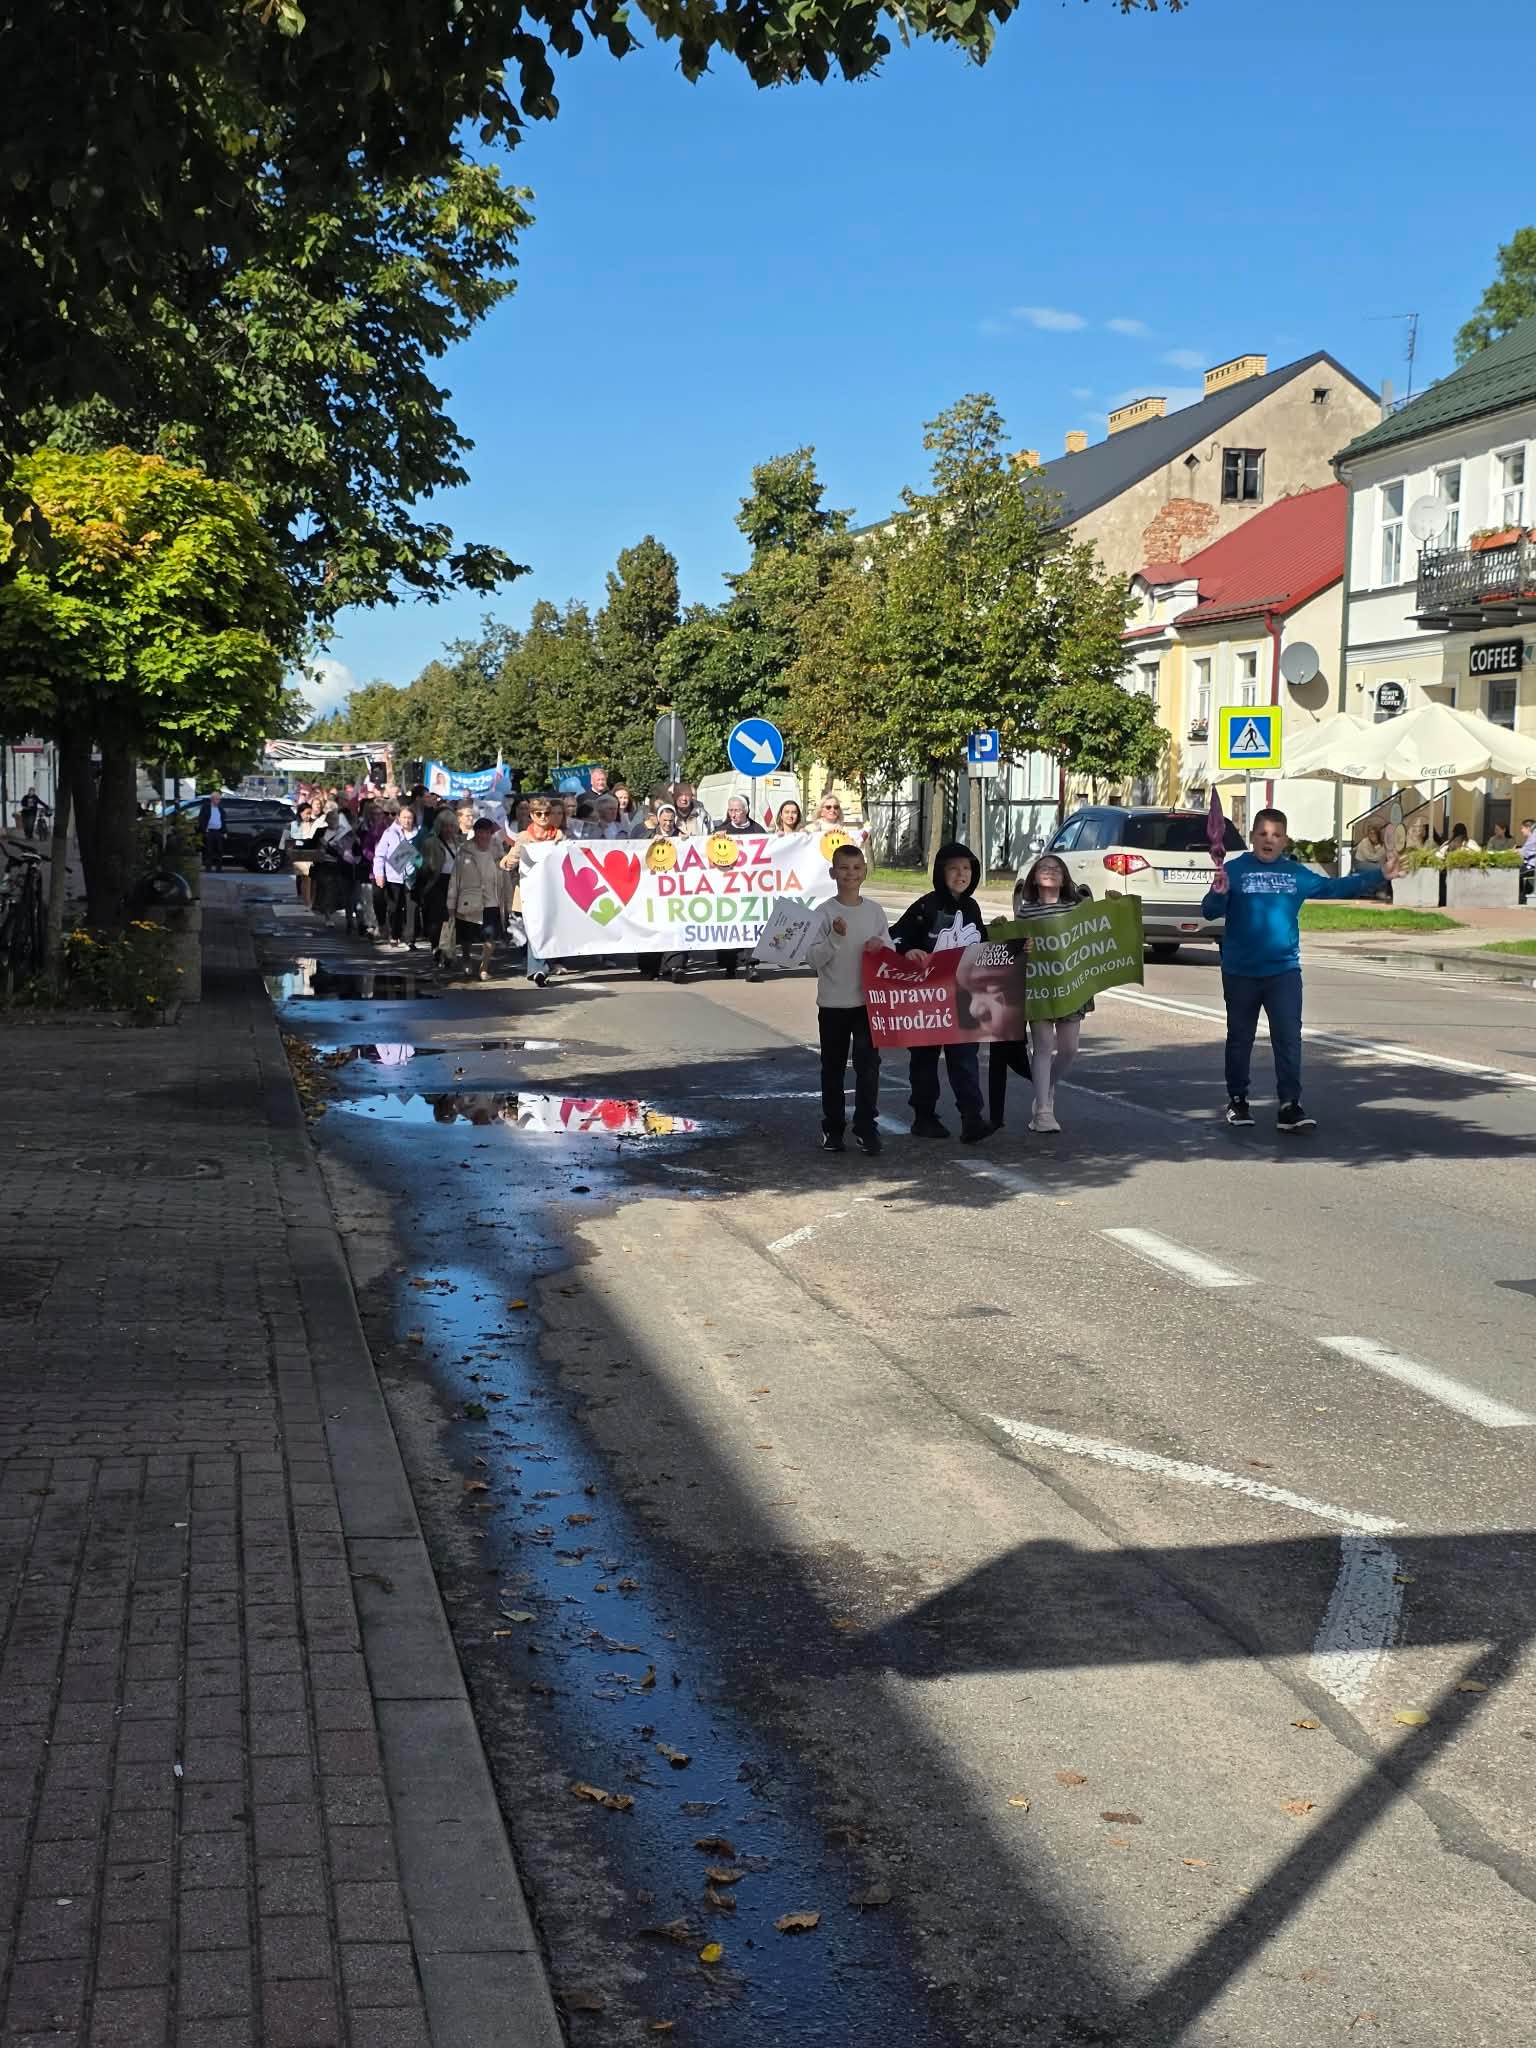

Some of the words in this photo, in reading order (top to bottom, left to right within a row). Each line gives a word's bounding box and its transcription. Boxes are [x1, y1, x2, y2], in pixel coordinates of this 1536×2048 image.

[1471, 646, 1517, 671] COFFEE
[975, 734, 993, 758] P
[658, 874, 715, 897] DLA
[1170, 870, 1182, 880] BS
[1185, 870, 1212, 881] 7244
[647, 899, 654, 923] I
[668, 896, 817, 922] RODZIY
[684, 924, 764, 943] SUWAŁK
[1035, 915, 1112, 951] RODZINA
[975, 954, 1015, 966] URODZIĆ
[1026, 938, 1118, 978] DNOCZONA
[868, 989, 887, 1004] ma
[889, 987, 947, 1009] prawo
[1026, 987, 1050, 1000] ZŁO
[1052, 984, 1071, 998] JEJ
[871, 1010, 886, 1036] się
[888, 1008, 953, 1031] urodzić
